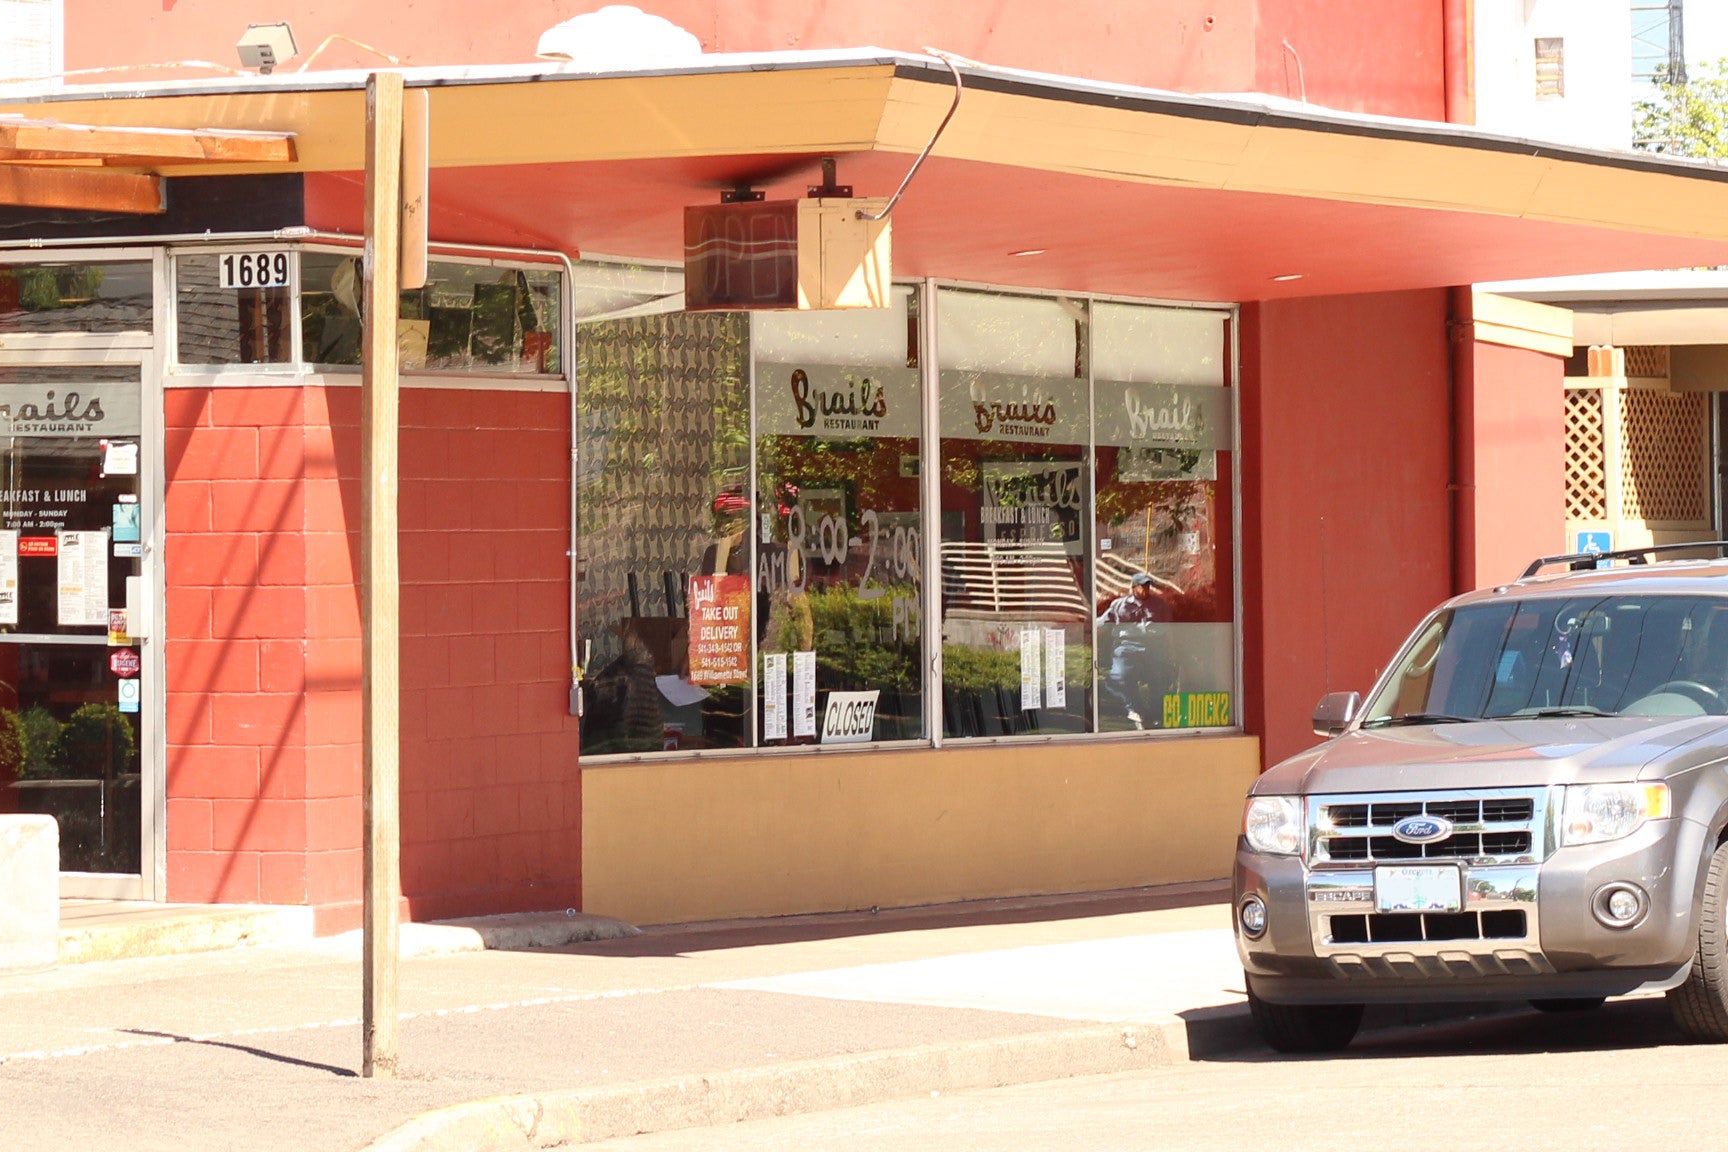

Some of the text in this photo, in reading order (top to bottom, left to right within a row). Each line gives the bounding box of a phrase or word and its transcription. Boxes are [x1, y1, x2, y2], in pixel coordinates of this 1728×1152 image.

[223, 254, 288, 287] 1689
[791, 368, 888, 430] Brails
[824, 418, 880, 431] RESTAURANT
[43, 490, 52, 503] &
[54, 489, 87, 503] LUNCH
[38, 509, 68, 518] SUNDAY
[980, 507, 1018, 524] BREAKFAST
[1028, 507, 1050, 524] LUNCH
[757, 551, 786, 594] AM
[701, 606, 739, 621] TAKE OUT
[892, 597, 921, 641] PM
[700, 625, 739, 640] DELIVERY
[733, 642, 742, 652] OR
[826, 700, 874, 737] CLOSED
[1405, 822, 1433, 835] Ford
[1314, 892, 1371, 902] ESCAPE
